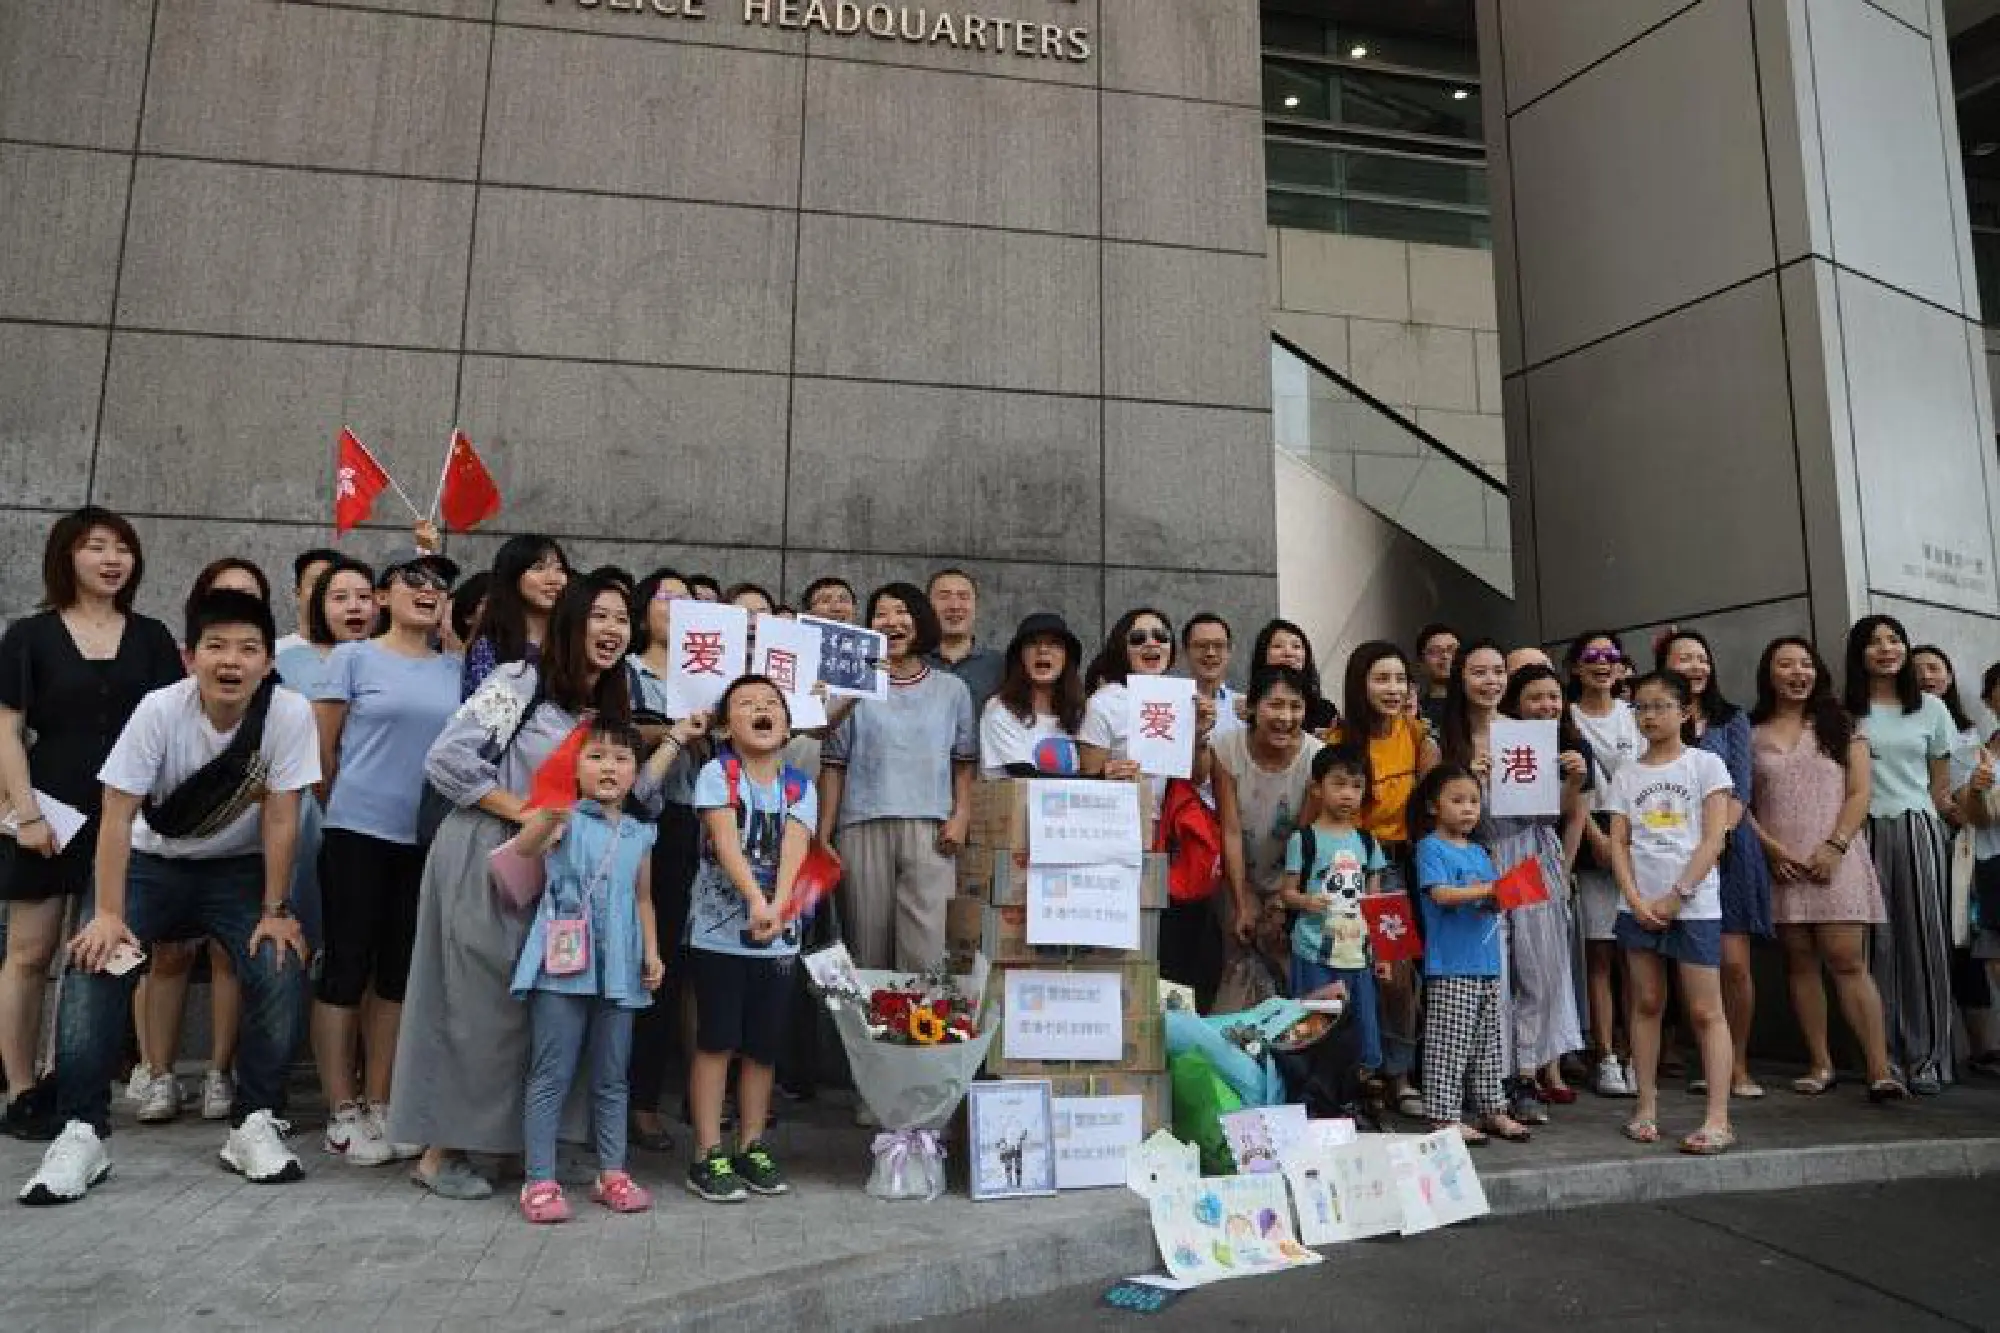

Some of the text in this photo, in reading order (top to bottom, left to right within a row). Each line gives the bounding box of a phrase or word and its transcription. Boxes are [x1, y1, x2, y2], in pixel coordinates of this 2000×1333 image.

[744, 0, 1091, 60] HEADQUARTERS
[682, 629, 725, 675] 爱
[766, 647, 797, 693] 国
[1139, 702, 1176, 740] 爱
[1502, 744, 1538, 783] 港
